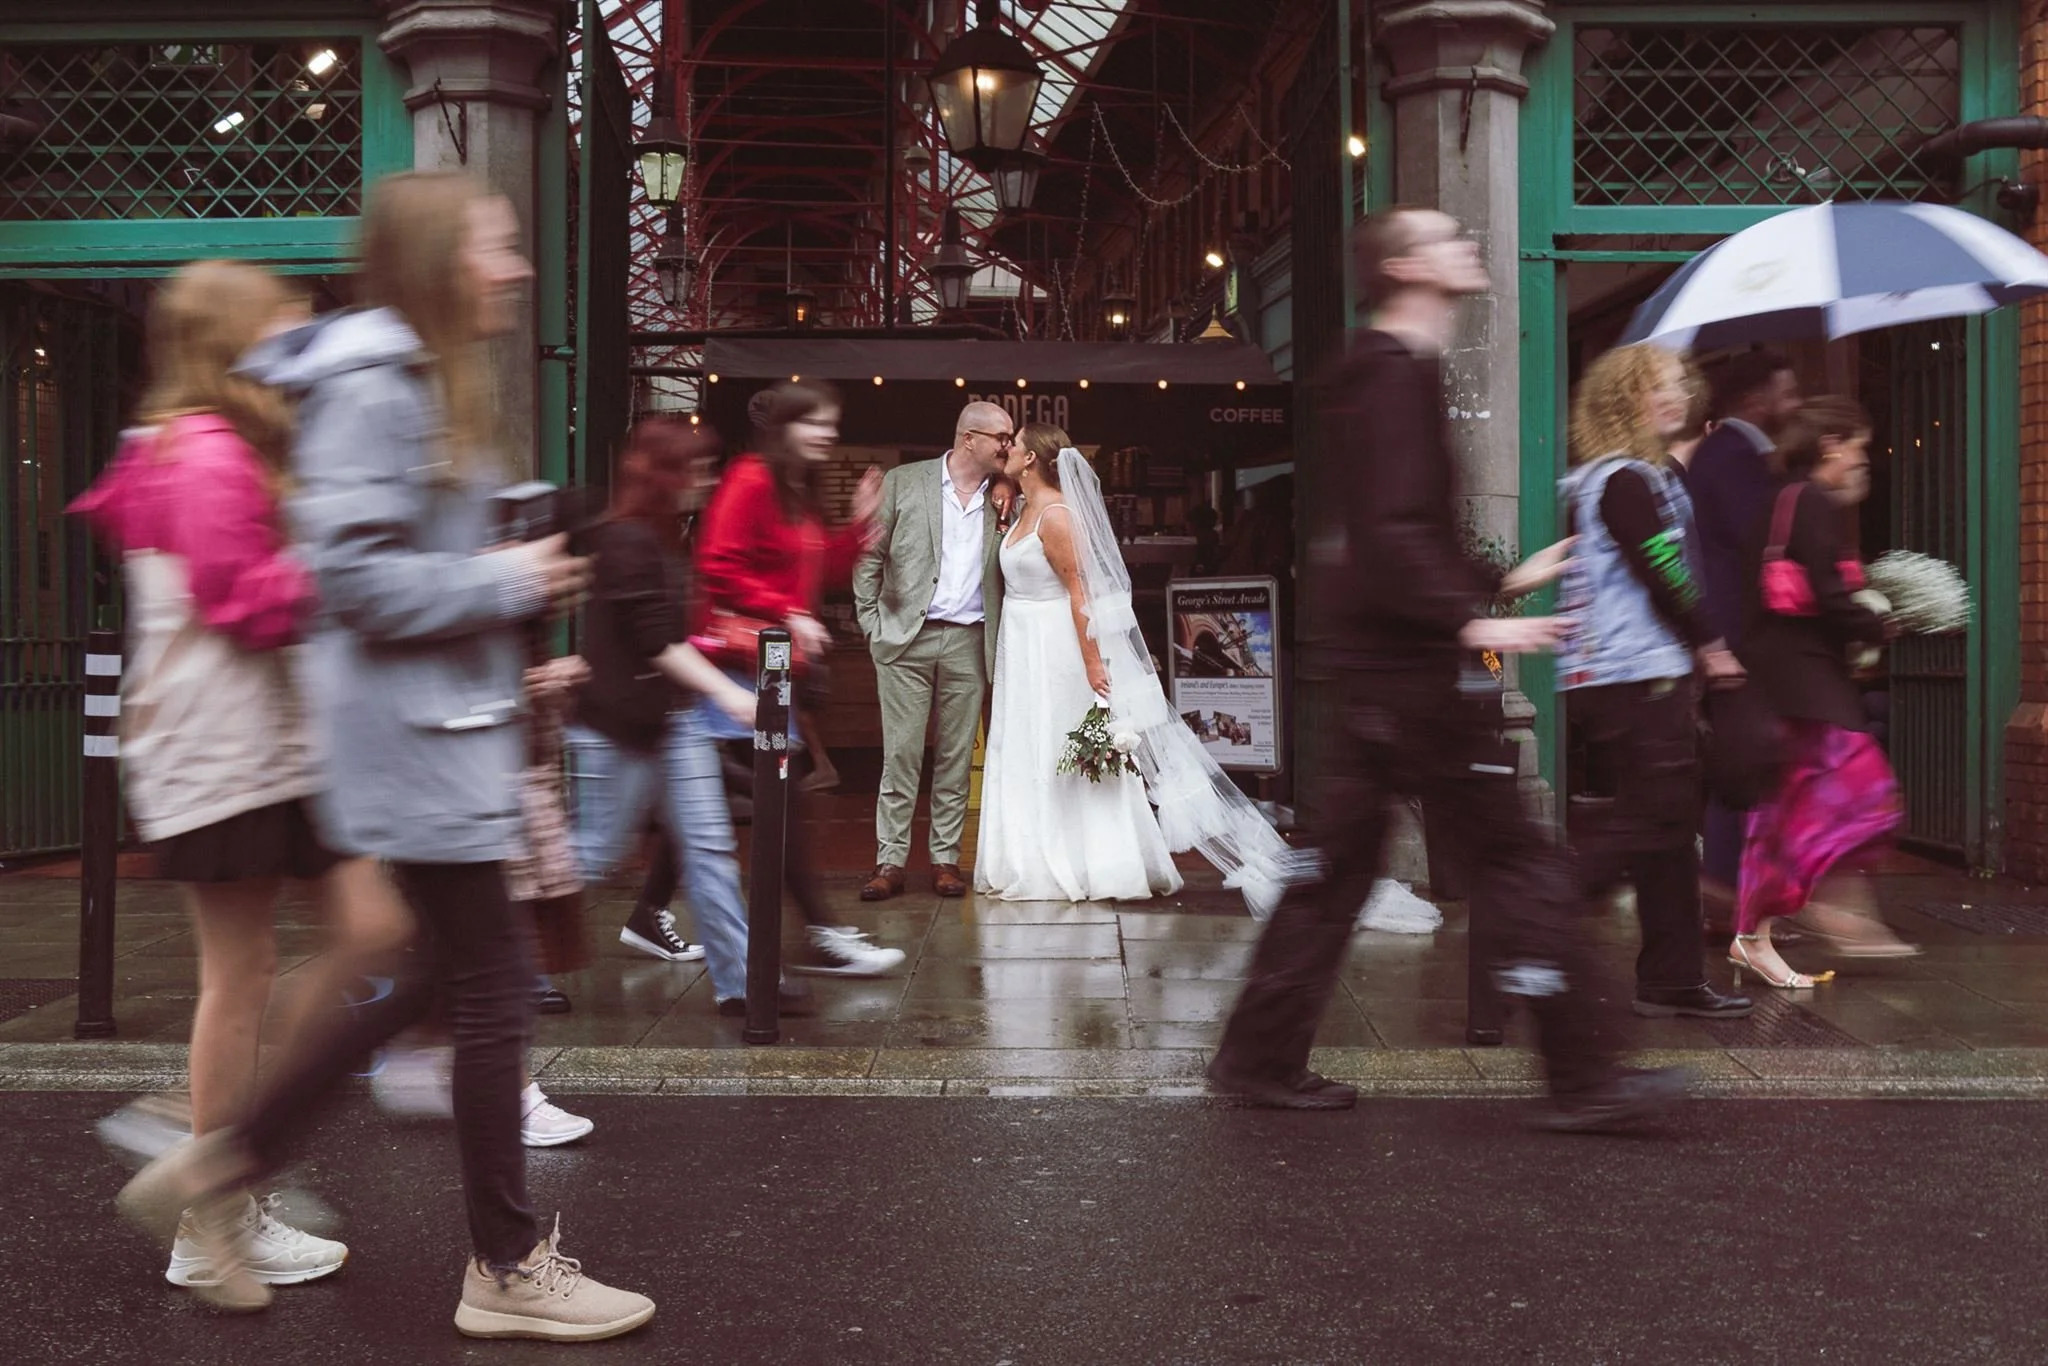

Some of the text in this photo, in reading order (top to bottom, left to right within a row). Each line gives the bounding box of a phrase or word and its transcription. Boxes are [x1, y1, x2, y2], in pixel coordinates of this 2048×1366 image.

[968, 394, 1069, 431] DEGA
[1210, 408, 1284, 423] COFFEE
[1177, 592, 1266, 608] George's Street Arcade
